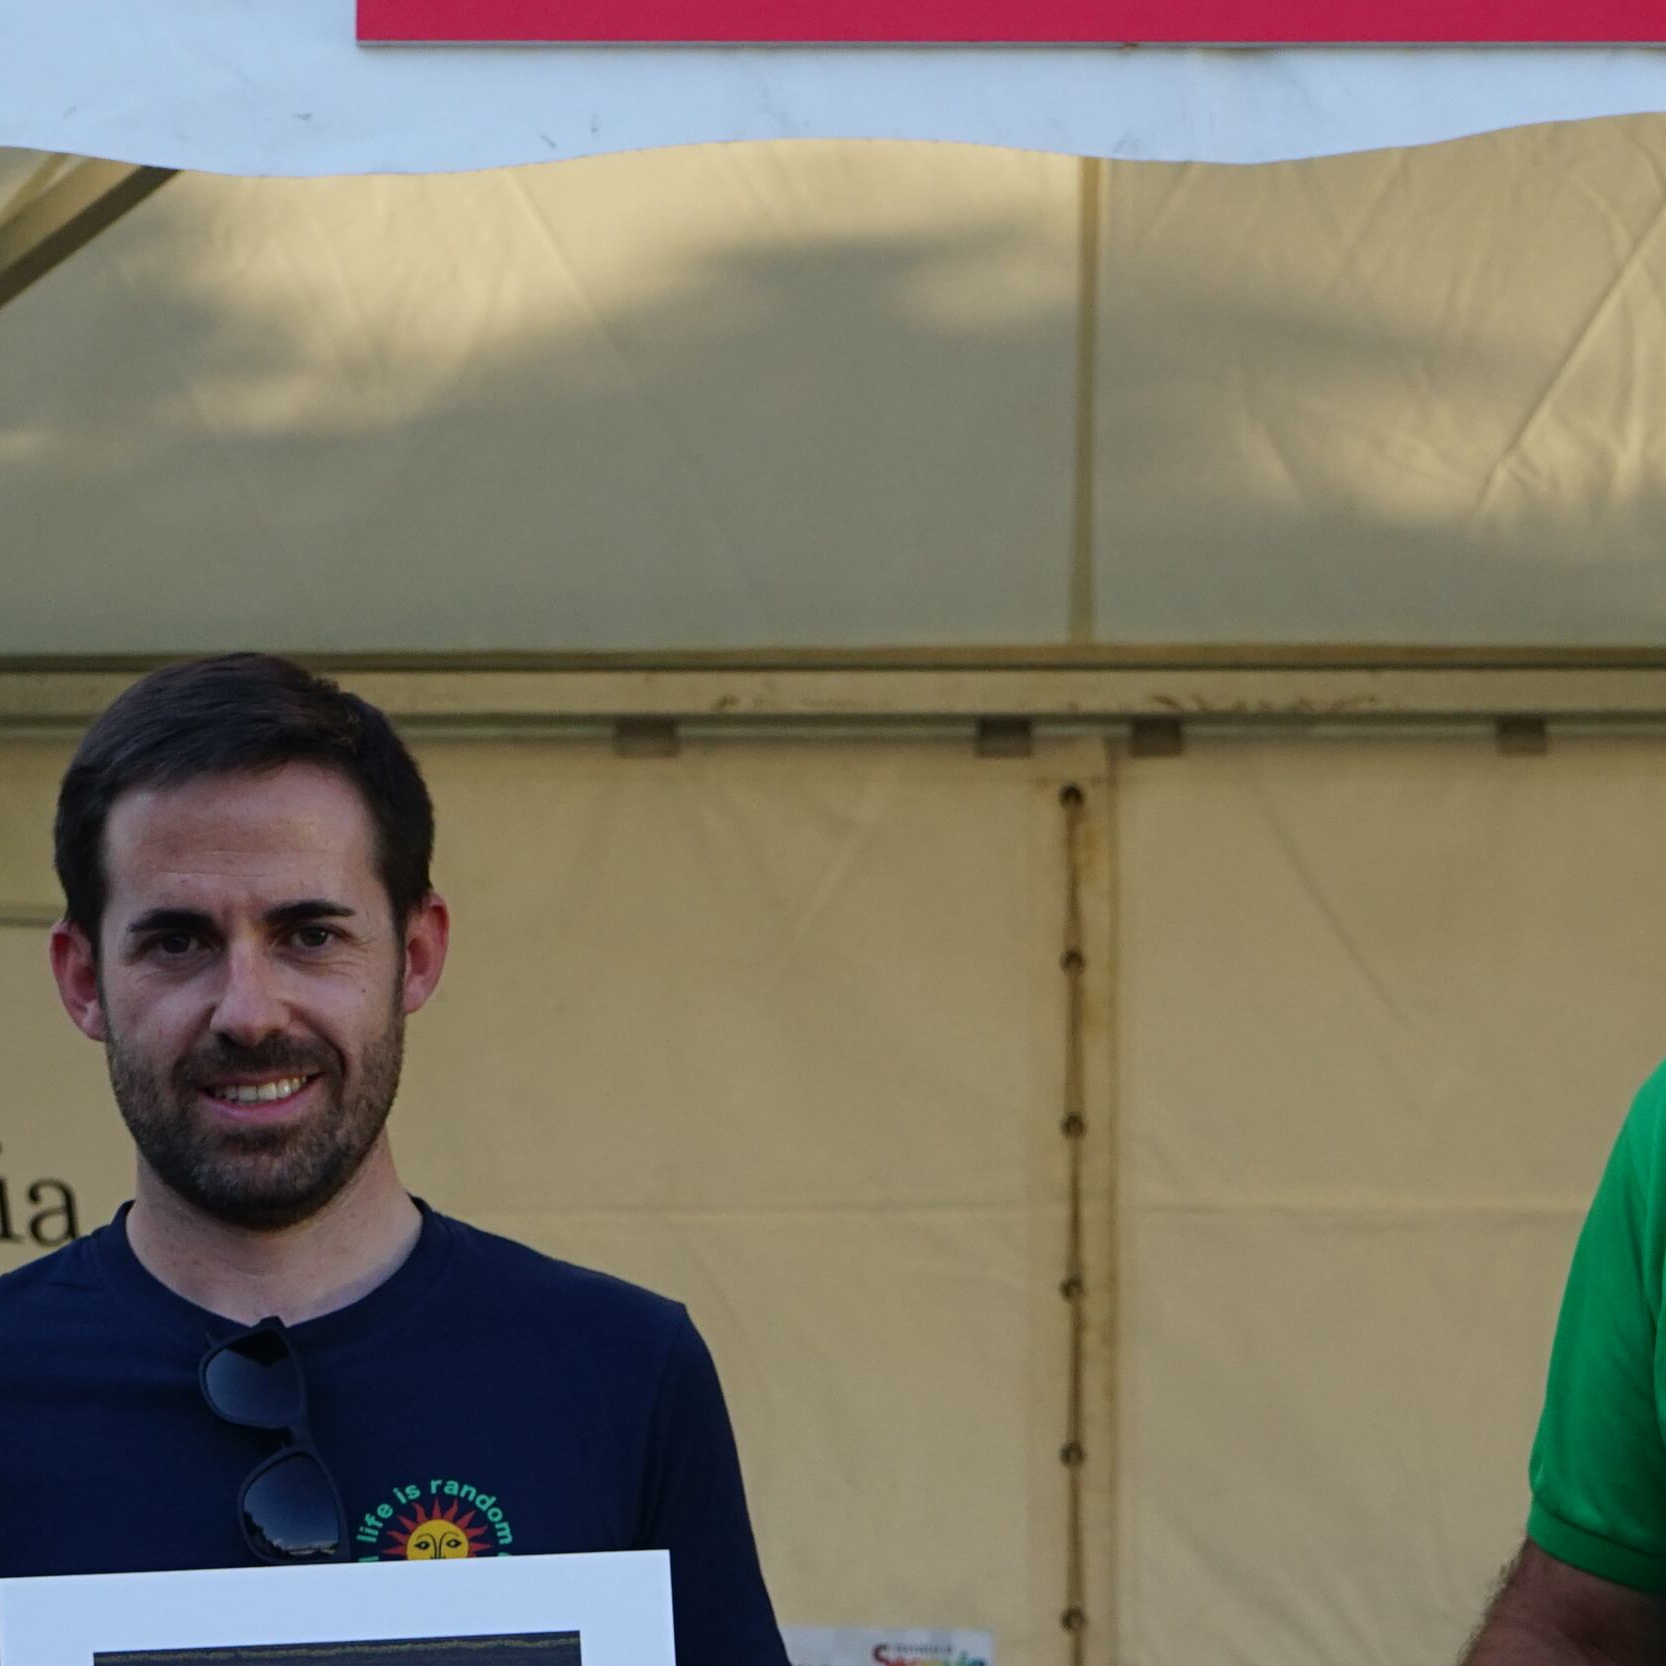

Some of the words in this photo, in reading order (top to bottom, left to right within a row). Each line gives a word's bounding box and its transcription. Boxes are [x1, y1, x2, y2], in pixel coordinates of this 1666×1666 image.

[357, 1503, 393, 1543] life
[393, 1483, 421, 1504] is
[430, 1479, 515, 1545] random
